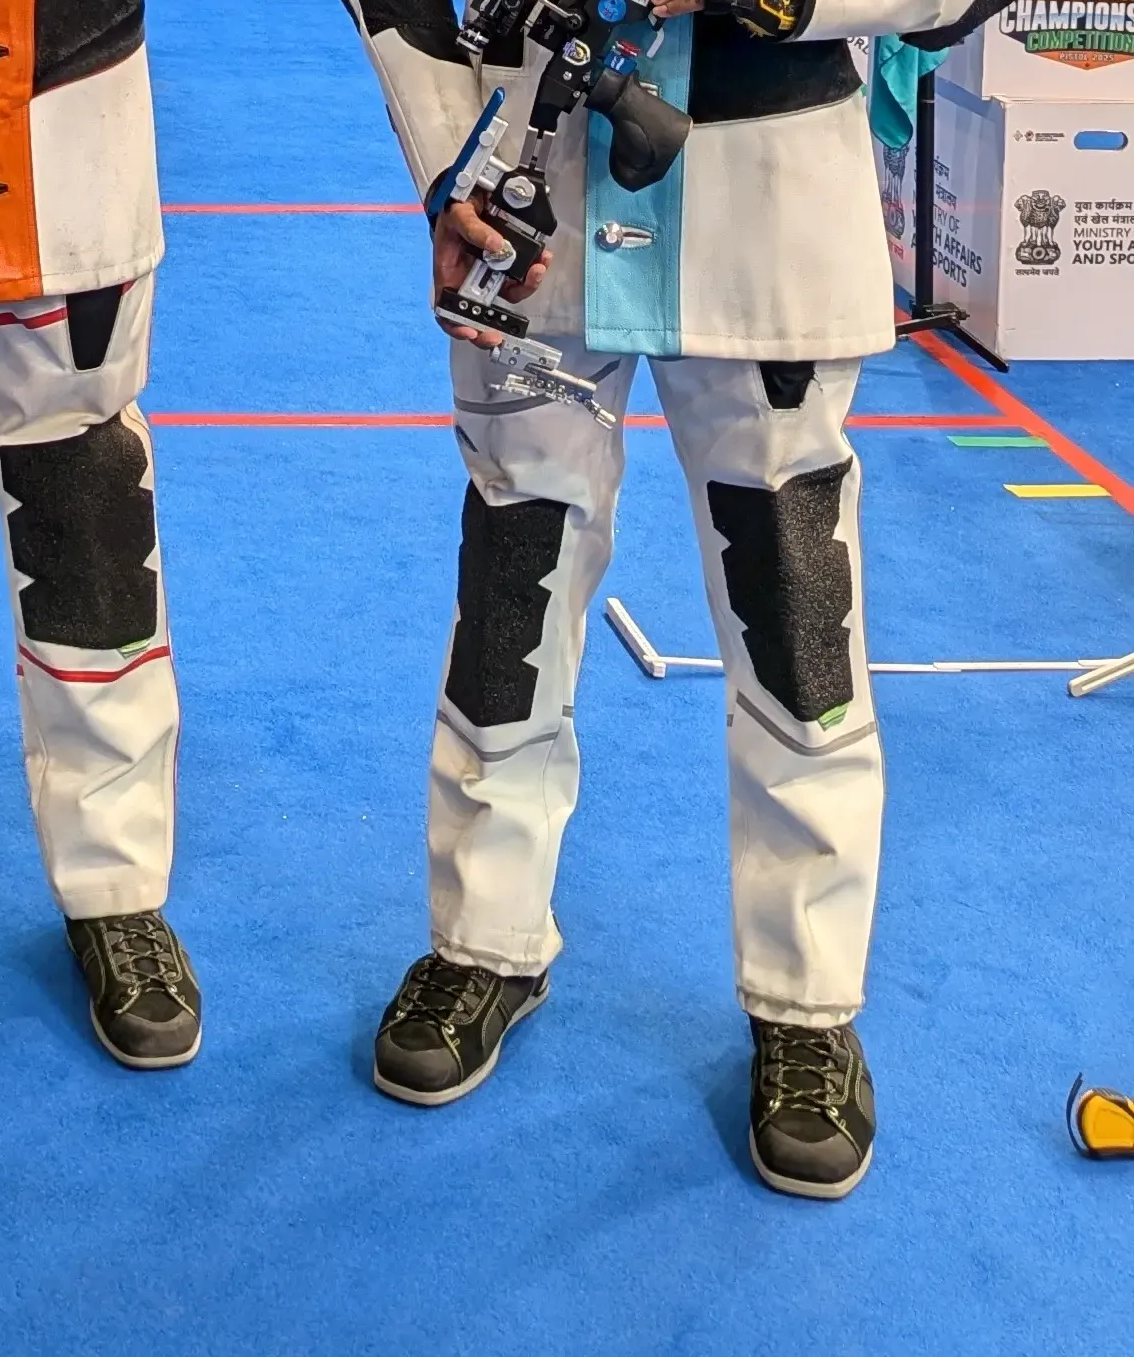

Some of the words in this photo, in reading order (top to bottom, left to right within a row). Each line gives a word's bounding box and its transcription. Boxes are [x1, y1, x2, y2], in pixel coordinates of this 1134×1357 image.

[1000, 0, 1134, 33] CHAMPIONS
[1026, 31, 1134, 53] COMPETITION
[1059, 52, 1088, 61] PISTOL
[949, 215, 960, 234] OF
[1112, 213, 1134, 224] मंत्रा
[1073, 228, 1131, 238] MINISTRY
[1073, 240, 1123, 251] YOUTH
[944, 233, 982, 275] AFFAIRS
[1072, 253, 1105, 265] AND
[1109, 253, 1134, 265] SPO
[932, 248, 967, 287] SPORTS
